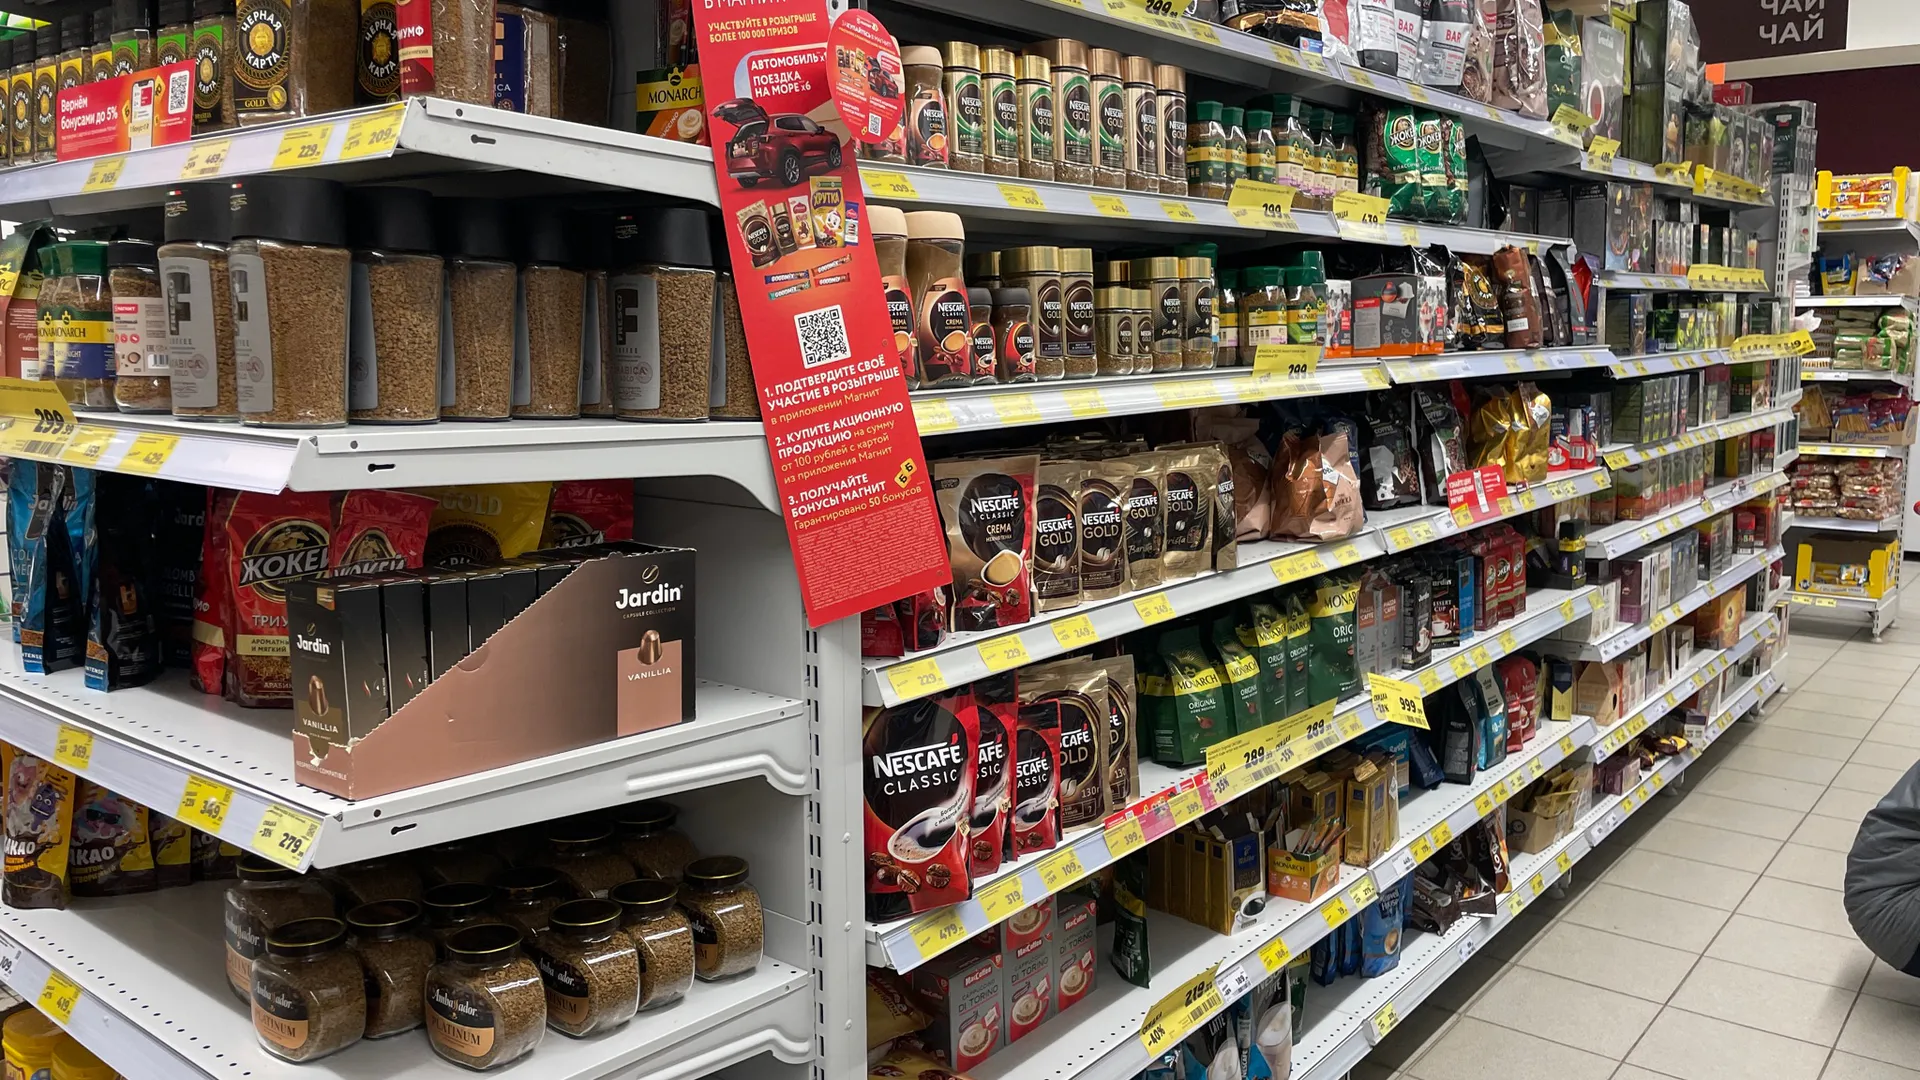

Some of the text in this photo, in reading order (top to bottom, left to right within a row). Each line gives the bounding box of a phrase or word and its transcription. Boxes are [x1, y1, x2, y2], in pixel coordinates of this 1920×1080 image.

[241, 10, 282, 32] ЧЕРНАЯ
[708, 12, 817, 32] УЧАСТВУЙТЕ В РОЗЫГРЫШЕ
[1398, 19, 1414, 34] BAR
[1759, 12, 1824, 45] ЧАЙ
[710, 25, 799, 43] БОЛЕЕ 100 000 ПРИЗОВ
[1445, 29, 1462, 43] BAR
[195, 46, 218, 65] ЧЕРНАЯ
[245, 51, 281, 70] КАРТА
[751, 53, 819, 71] АВТОМОБИЛЬ
[368, 60, 396, 78] КАРТА
[753, 71, 801, 87] ПОЕЗДКА
[648, 86, 700, 104] MONARCH
[755, 86, 775, 98] НА
[776, 81, 800, 95] МОРЕ
[61, 96, 88, 113] Вернём
[244, 98, 265, 108] GOLD
[61, 105, 118, 130] бонусами до 5%
[889, 182, 909, 193] 209
[813, 191, 840, 207] ХРУТКА
[53, 328, 86, 338] MONARCH
[764, 354, 886, 398] 1. ПОДТВЕРДИТЕ СВОЁ
[767, 366, 900, 411] УЧАСТИЕ В РОЗЫГРЫШЕ
[33, 408, 64, 434] 299
[771, 417, 778, 425] в
[780, 398, 843, 425] приложении
[774, 401, 904, 447] 2. КУПИТЕ АКЦИОННУЮ
[778, 419, 895, 459] ПРОДУКЦИЮ на сумму
[781, 463, 793, 472] от
[794, 455, 812, 469] 100
[813, 444, 849, 467] рублей
[857, 432, 890, 450] картой
[784, 445, 893, 484] из приложения Магнит
[788, 473, 869, 506] 3. ПОЛУЧАЙТЕ
[1167, 486, 1193, 501] ESCAFÉ
[441, 492, 501, 516] GOLD
[791, 481, 887, 518] БОНУСЫ МАГНИТ
[794, 484, 923, 531] Гарантировано 50 бонусов
[970, 489, 1020, 514] NESCAFÉ
[979, 510, 1015, 521] CLASSIC
[1130, 506, 1157, 519] GOLD
[986, 522, 1012, 536] CREMA
[1040, 530, 1073, 547] GOLD
[1083, 523, 1119, 540] GOLD
[615, 583, 681, 610] Jardin
[622, 606, 677, 620] CAPSULE COLLECTION
[1073, 626, 1090, 639] 249
[1333, 623, 1354, 638] ORIG
[257, 645, 287, 653] МЯГКИЙ
[297, 634, 331, 656] Jardin
[1004, 648, 1020, 659] 229
[627, 666, 672, 682] VANILLIA
[1230, 661, 1259, 678] MONARCH
[918, 673, 936, 686] 229
[1176, 675, 1219, 691] MONARCH
[1188, 698, 1216, 710] ORIGINAL
[1399, 697, 1416, 713] 999
[303, 717, 339, 734] VANILLIA
[1306, 719, 1325, 739] 289
[872, 733, 963, 779] NESCAFÉ
[1017, 751, 1050, 777] SCAFÉ
[1060, 746, 1089, 766] OLD
[1244, 746, 1265, 768] 289
[883, 768, 958, 796] CLASSIC
[1017, 773, 1048, 788] ASSIC
[200, 799, 220, 819] 349
[279, 832, 303, 854] 279
[1124, 832, 1138, 846] 399
[1273, 860, 1306, 873] MONARCH
[1005, 891, 1021, 905] 319
[939, 923, 958, 940] 479
[1017, 939, 1043, 958] MacCoffee
[1059, 930, 1093, 954] DI TORINO
[965, 966, 992, 986] MacCoffee
[1011, 956, 1049, 983] DI TORINO
[958, 984, 999, 1013] DI TORINO
[1184, 980, 1206, 1008] 219
[57, 997, 70, 1012] 419
[431, 1015, 481, 1047] PLATINUM
[1208, 1013, 1226, 1037] LATTE
[1147, 1024, 1166, 1047] -40%
